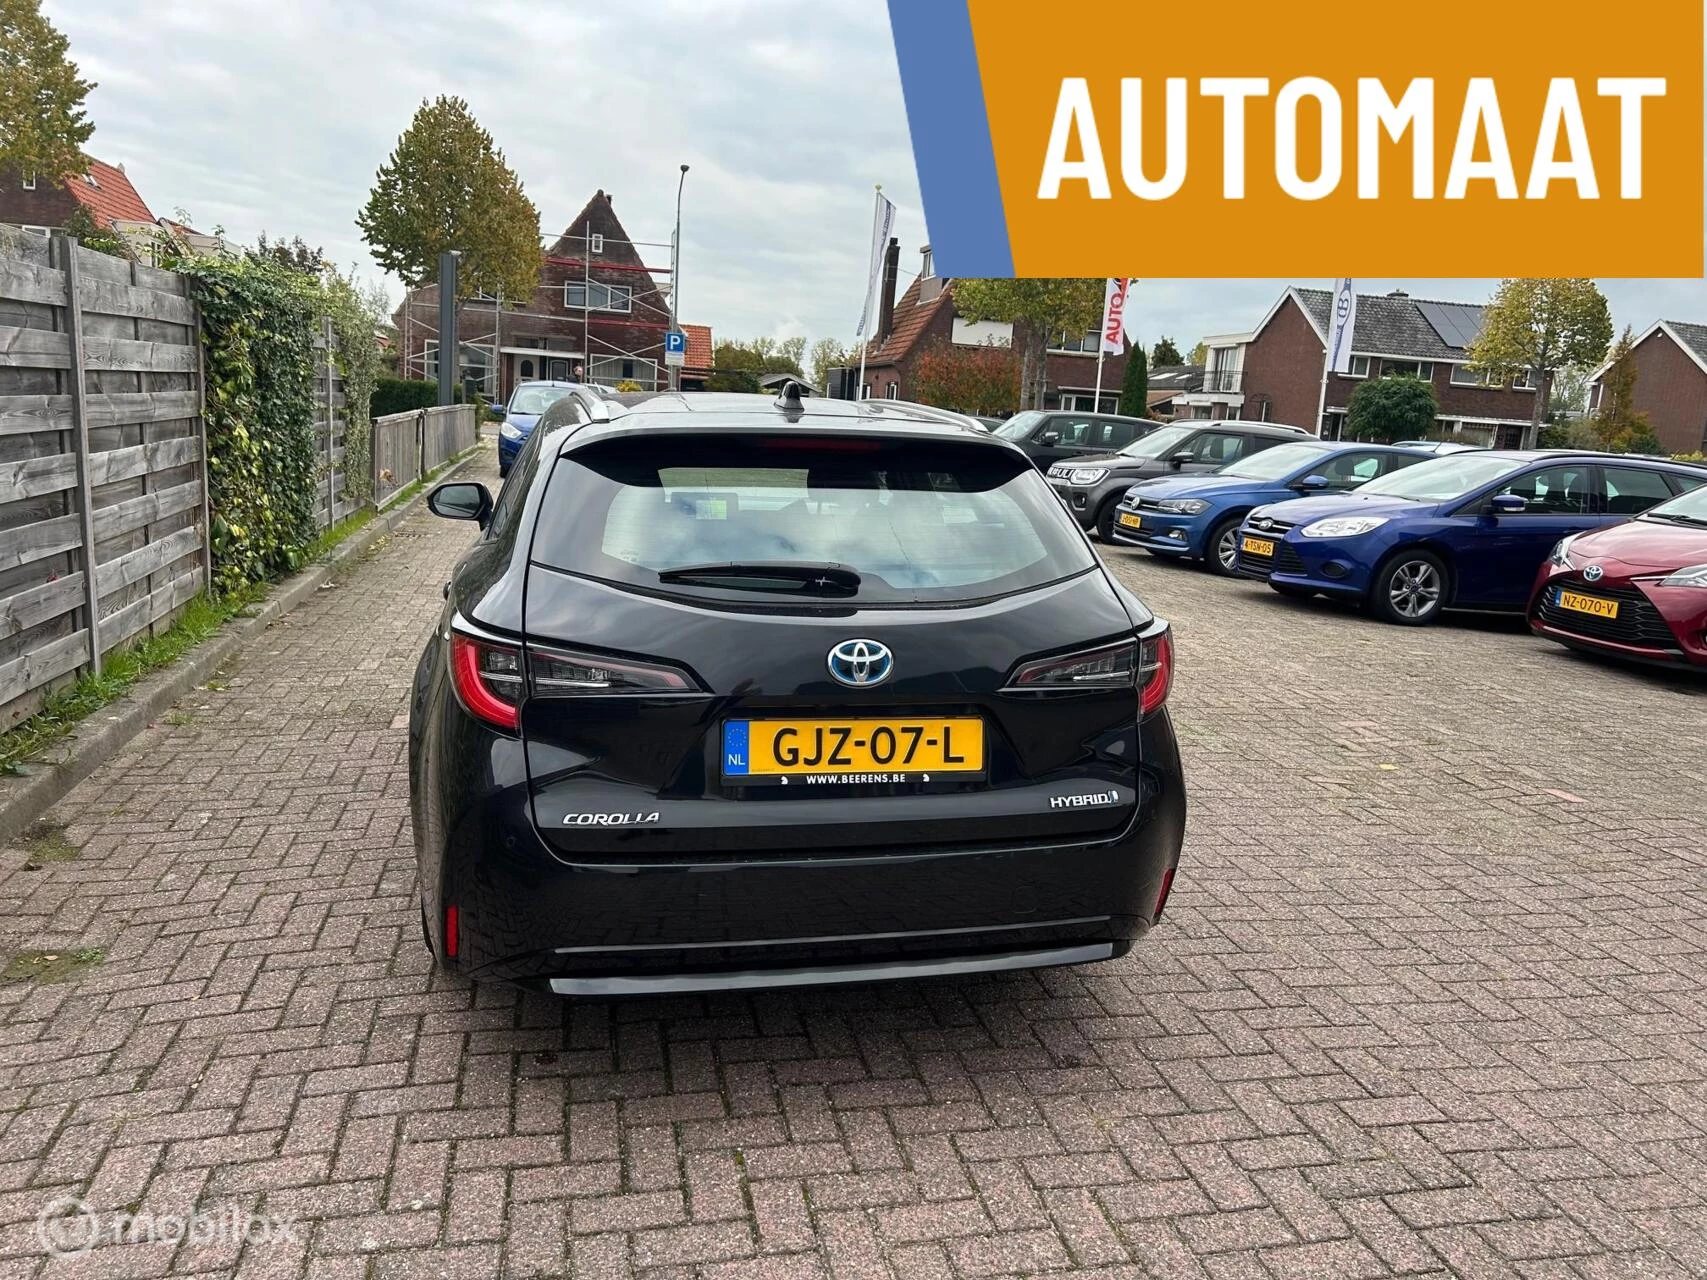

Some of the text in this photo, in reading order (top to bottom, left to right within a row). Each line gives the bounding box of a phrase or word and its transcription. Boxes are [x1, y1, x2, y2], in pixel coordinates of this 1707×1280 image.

[670, 335, 681, 350] P
[1563, 594, 1614, 615] NZ-070-V
[773, 726, 965, 767] GJZ-07-L
[728, 753, 745, 765] NL
[806, 773, 906, 784] WWW.BEERENS.BE
[1049, 793, 1109, 808] HYBRID
[562, 812, 660, 826] COROLLA
